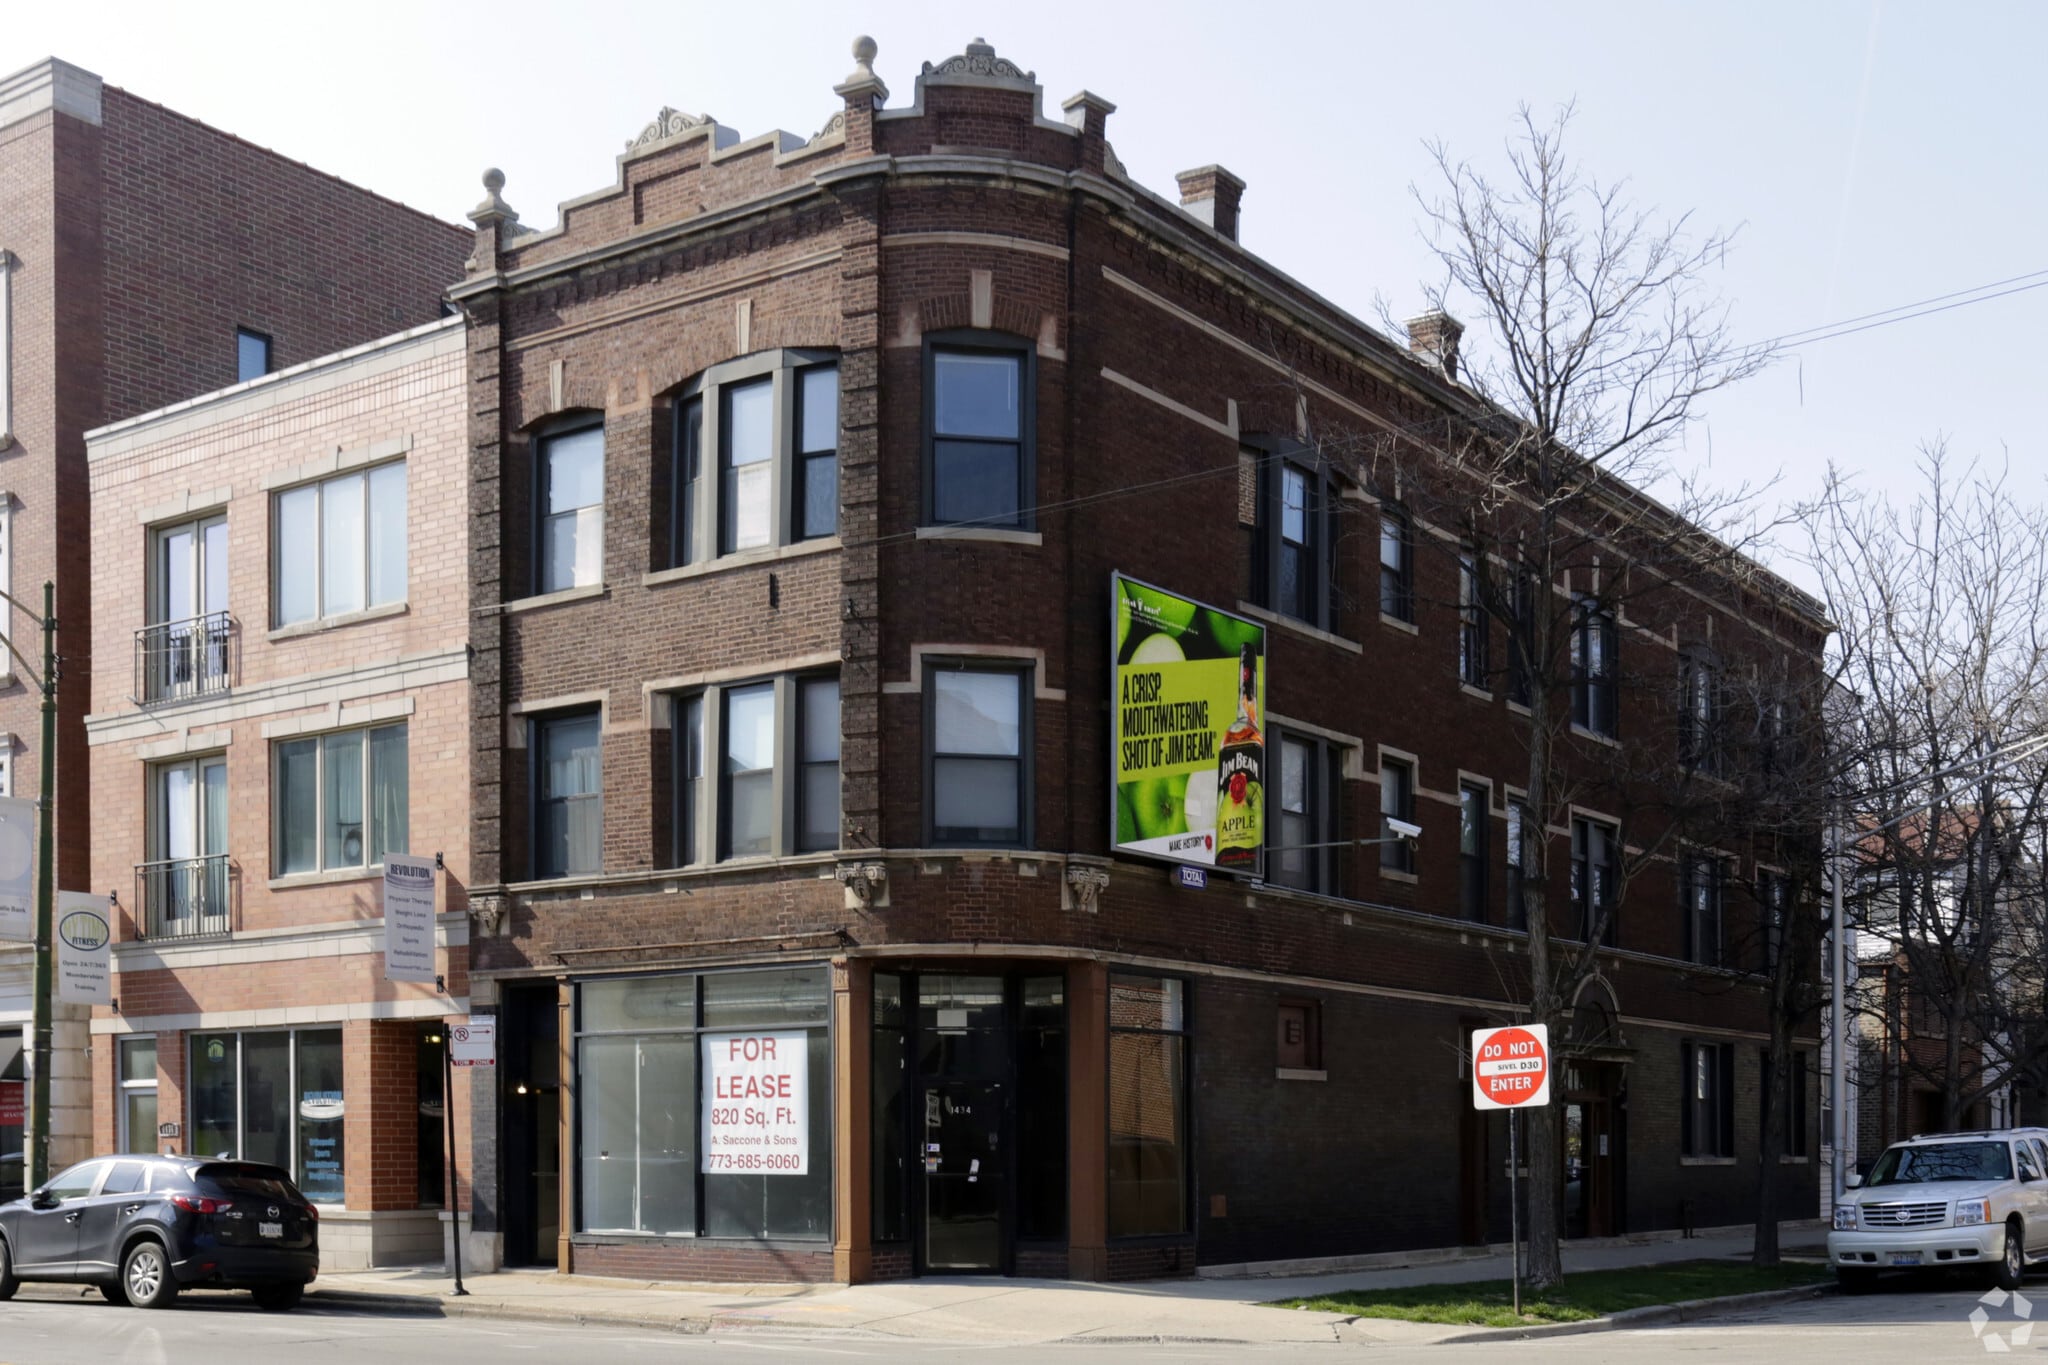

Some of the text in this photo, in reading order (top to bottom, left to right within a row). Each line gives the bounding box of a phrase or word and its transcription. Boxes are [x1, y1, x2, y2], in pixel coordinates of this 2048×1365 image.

[1123, 672, 1162, 704] A CRISP,
[1123, 700, 1208, 738] MOUTHWATERING
[1122, 739, 1149, 771] SHOT
[1151, 737, 1164, 767] OF
[1165, 734, 1184, 765] JIM
[1220, 752, 1259, 786] JIM BEAM
[1222, 815, 1255, 832] APPLE
[1169, 839, 1182, 852] MAKE
[390, 863, 430, 878] REVOLUTION
[1183, 868, 1204, 883] TOTAL
[72, 936, 99, 947] FITNESS
[729, 1036, 777, 1062] FOR
[1484, 1041, 1536, 1058] DO NOT
[716, 1074, 792, 1099] LEASE
[1490, 1076, 1532, 1092] ENTER
[711, 1107, 797, 1129] 820 Sq. Ft.
[711, 1135, 798, 1145] A. Saccone & Sons
[709, 1153, 800, 1169] 773-685-6060
